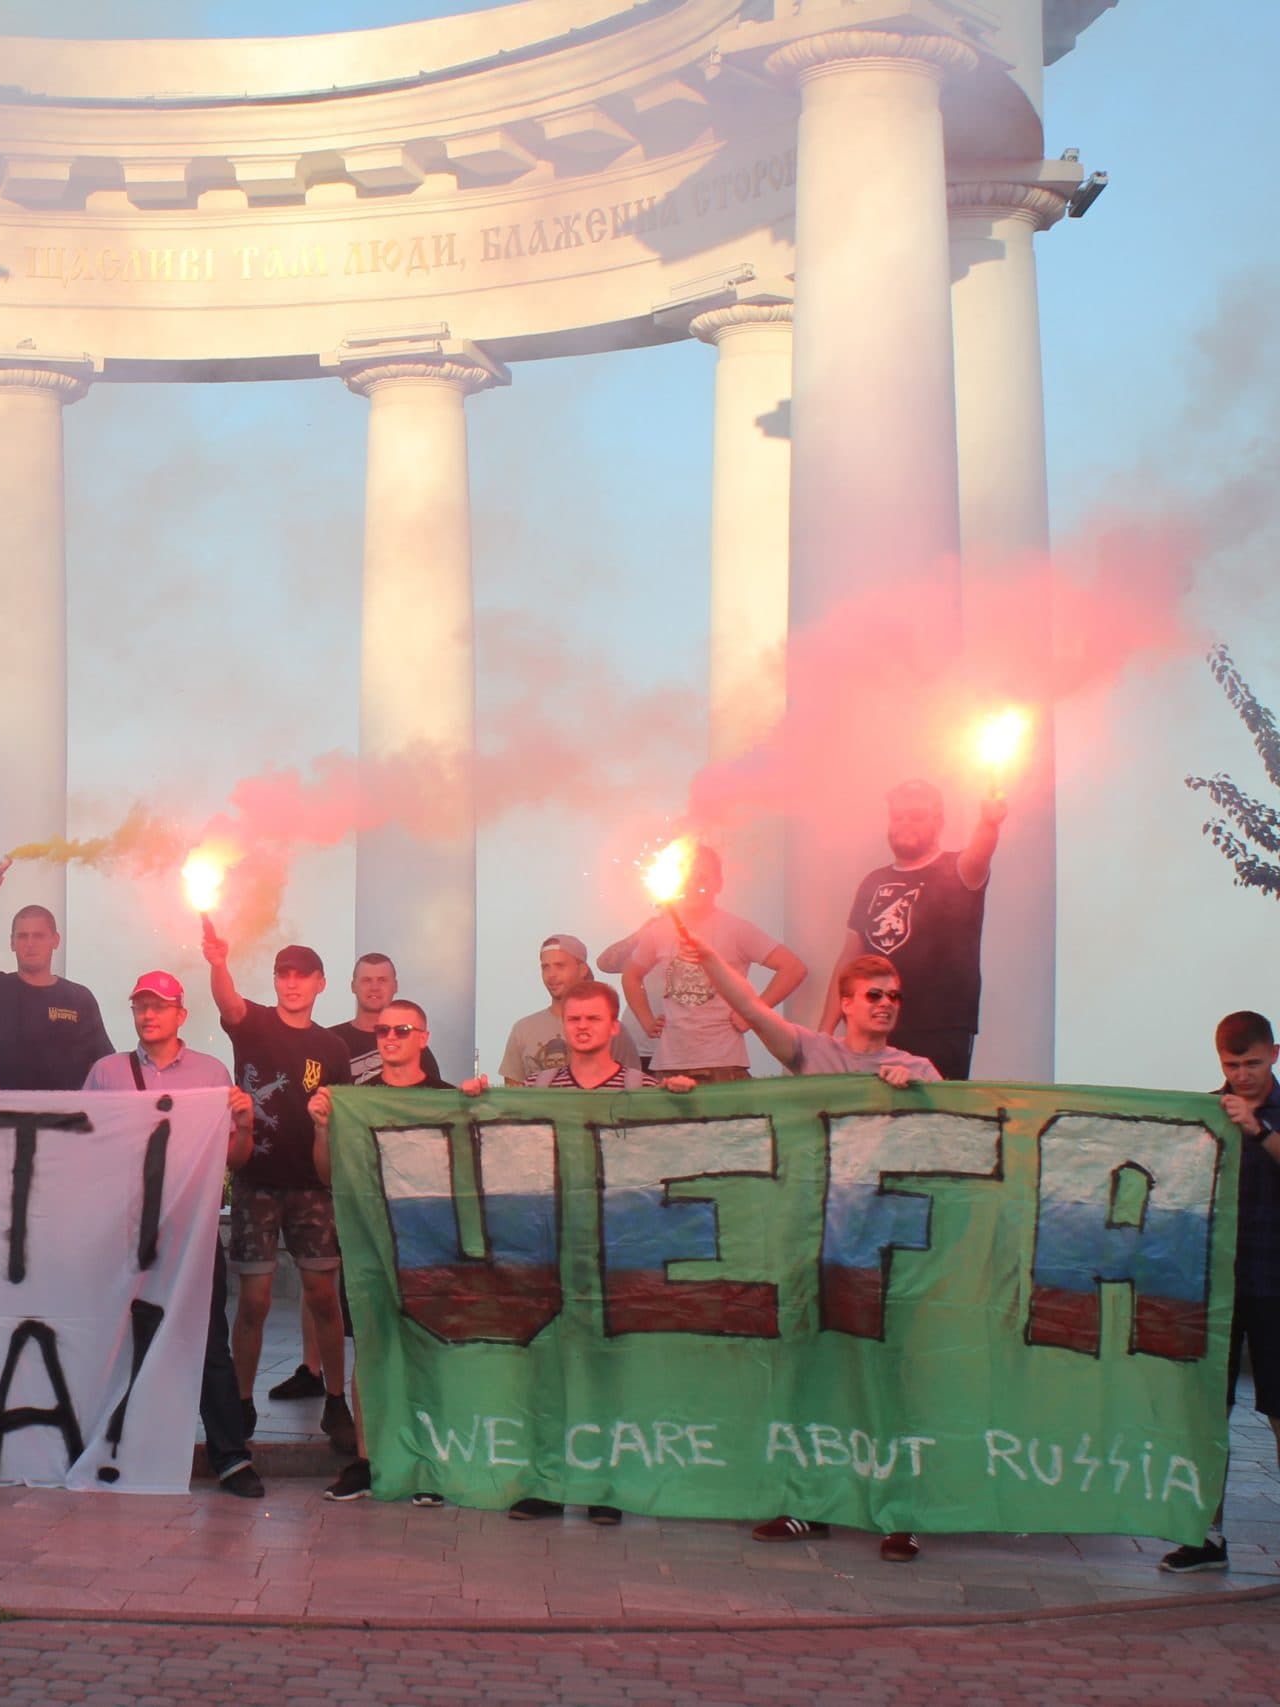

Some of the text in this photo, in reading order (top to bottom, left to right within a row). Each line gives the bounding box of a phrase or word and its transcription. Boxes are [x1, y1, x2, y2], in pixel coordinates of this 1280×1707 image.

[232, 243, 328, 281] ТАМ
[343, 232, 467, 278] ЛЮДИ,
[480, 193, 681, 262] БЛАЖЕННА
[691, 141, 797, 217] СТОРОН
[368, 1108, 1225, 1363] UEFA
[416, 1410, 529, 1468] WE
[564, 1420, 727, 1470] CARE
[764, 1422, 937, 1480] ABOUT
